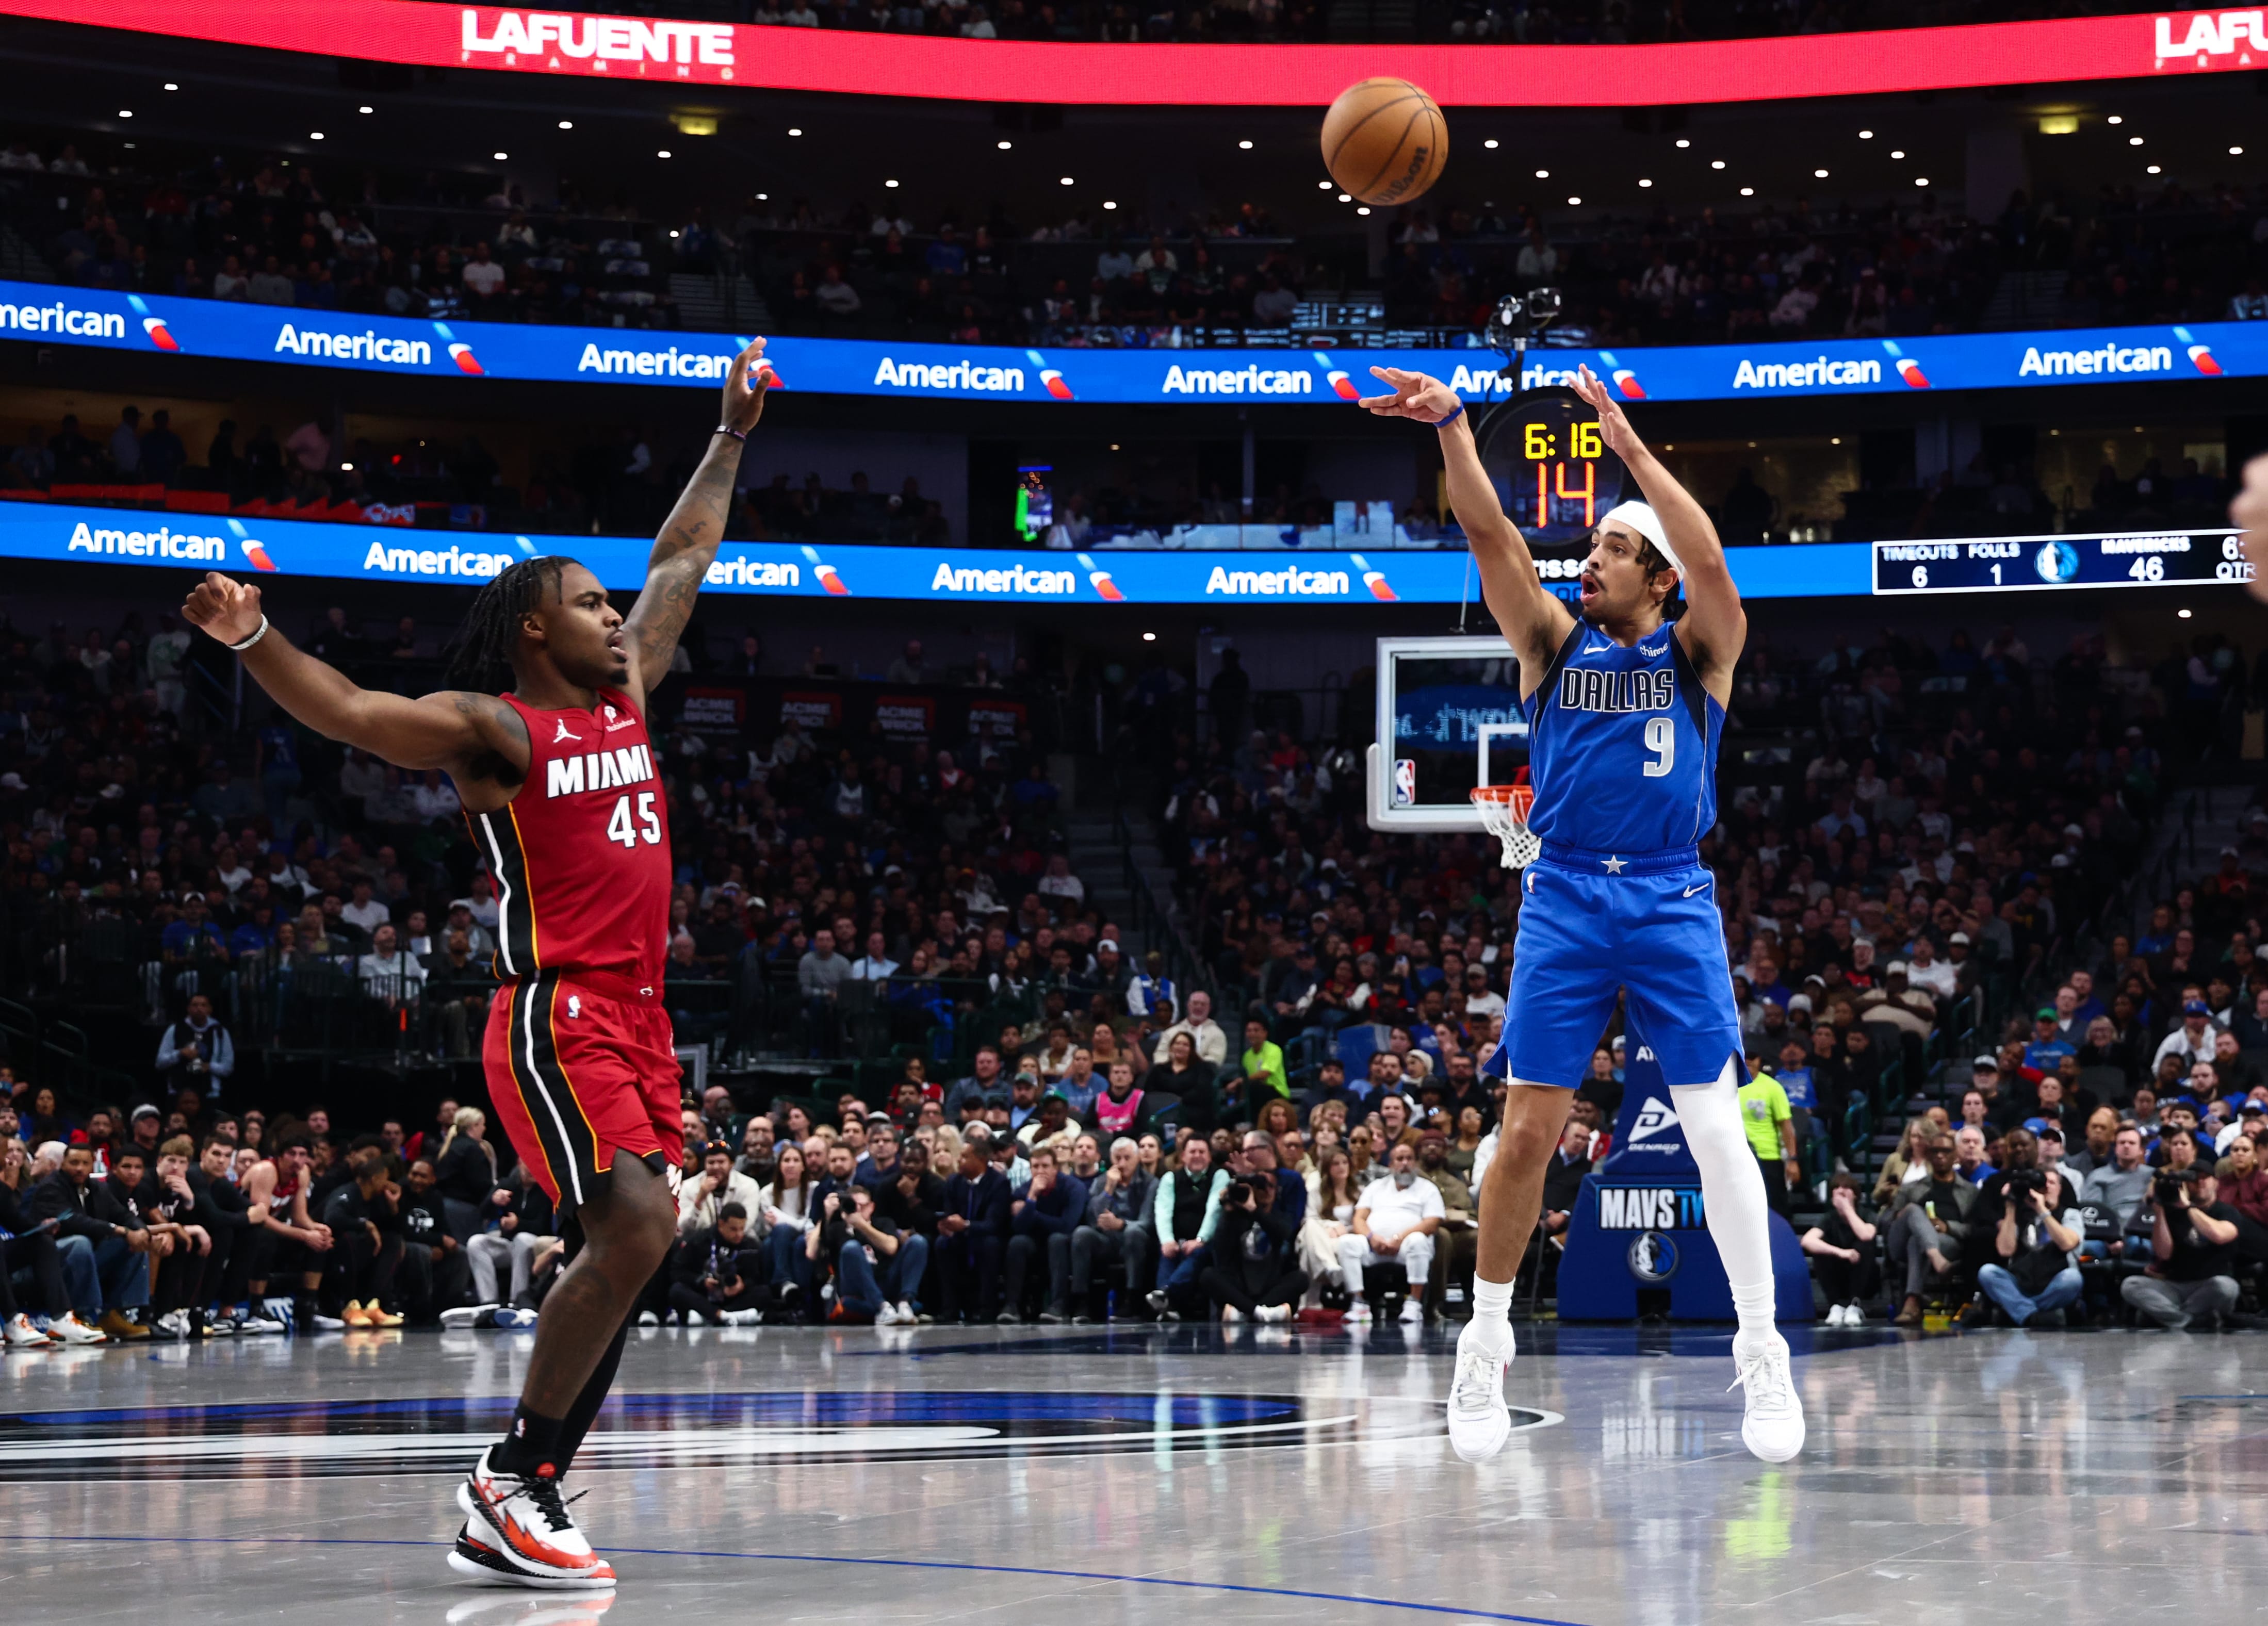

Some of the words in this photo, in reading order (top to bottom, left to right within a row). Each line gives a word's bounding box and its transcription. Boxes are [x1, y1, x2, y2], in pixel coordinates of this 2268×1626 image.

[462, 9, 734, 65] LAFUENTE
[275, 323, 431, 365] American
[578, 343, 733, 379] American
[2019, 342, 2172, 376] American
[874, 357, 1024, 391] American
[1162, 364, 1312, 393] American
[1733, 355, 1881, 389] American
[1525, 423, 1602, 459] 6:16
[1538, 462, 1594, 528] 14
[68, 522, 225, 561] American
[1882, 544, 1959, 561] TIMEOUTS
[1968, 542, 2021, 559] FOULS
[2101, 536, 2191, 554] MAVERICKS
[364, 541, 514, 577] American
[703, 555, 800, 586] erican
[1989, 563, 2002, 585] 1
[2128, 556, 2164, 581] 46
[932, 563, 1075, 594] American
[1205, 565, 1349, 595] American
[1912, 566, 1928, 587] 6
[1639, 643, 1669, 658] chime
[1560, 667, 1674, 713] DALLAS
[1643, 717, 1675, 777] 9
[547, 744, 655, 799] MIAMI
[606, 791, 662, 848] 45
